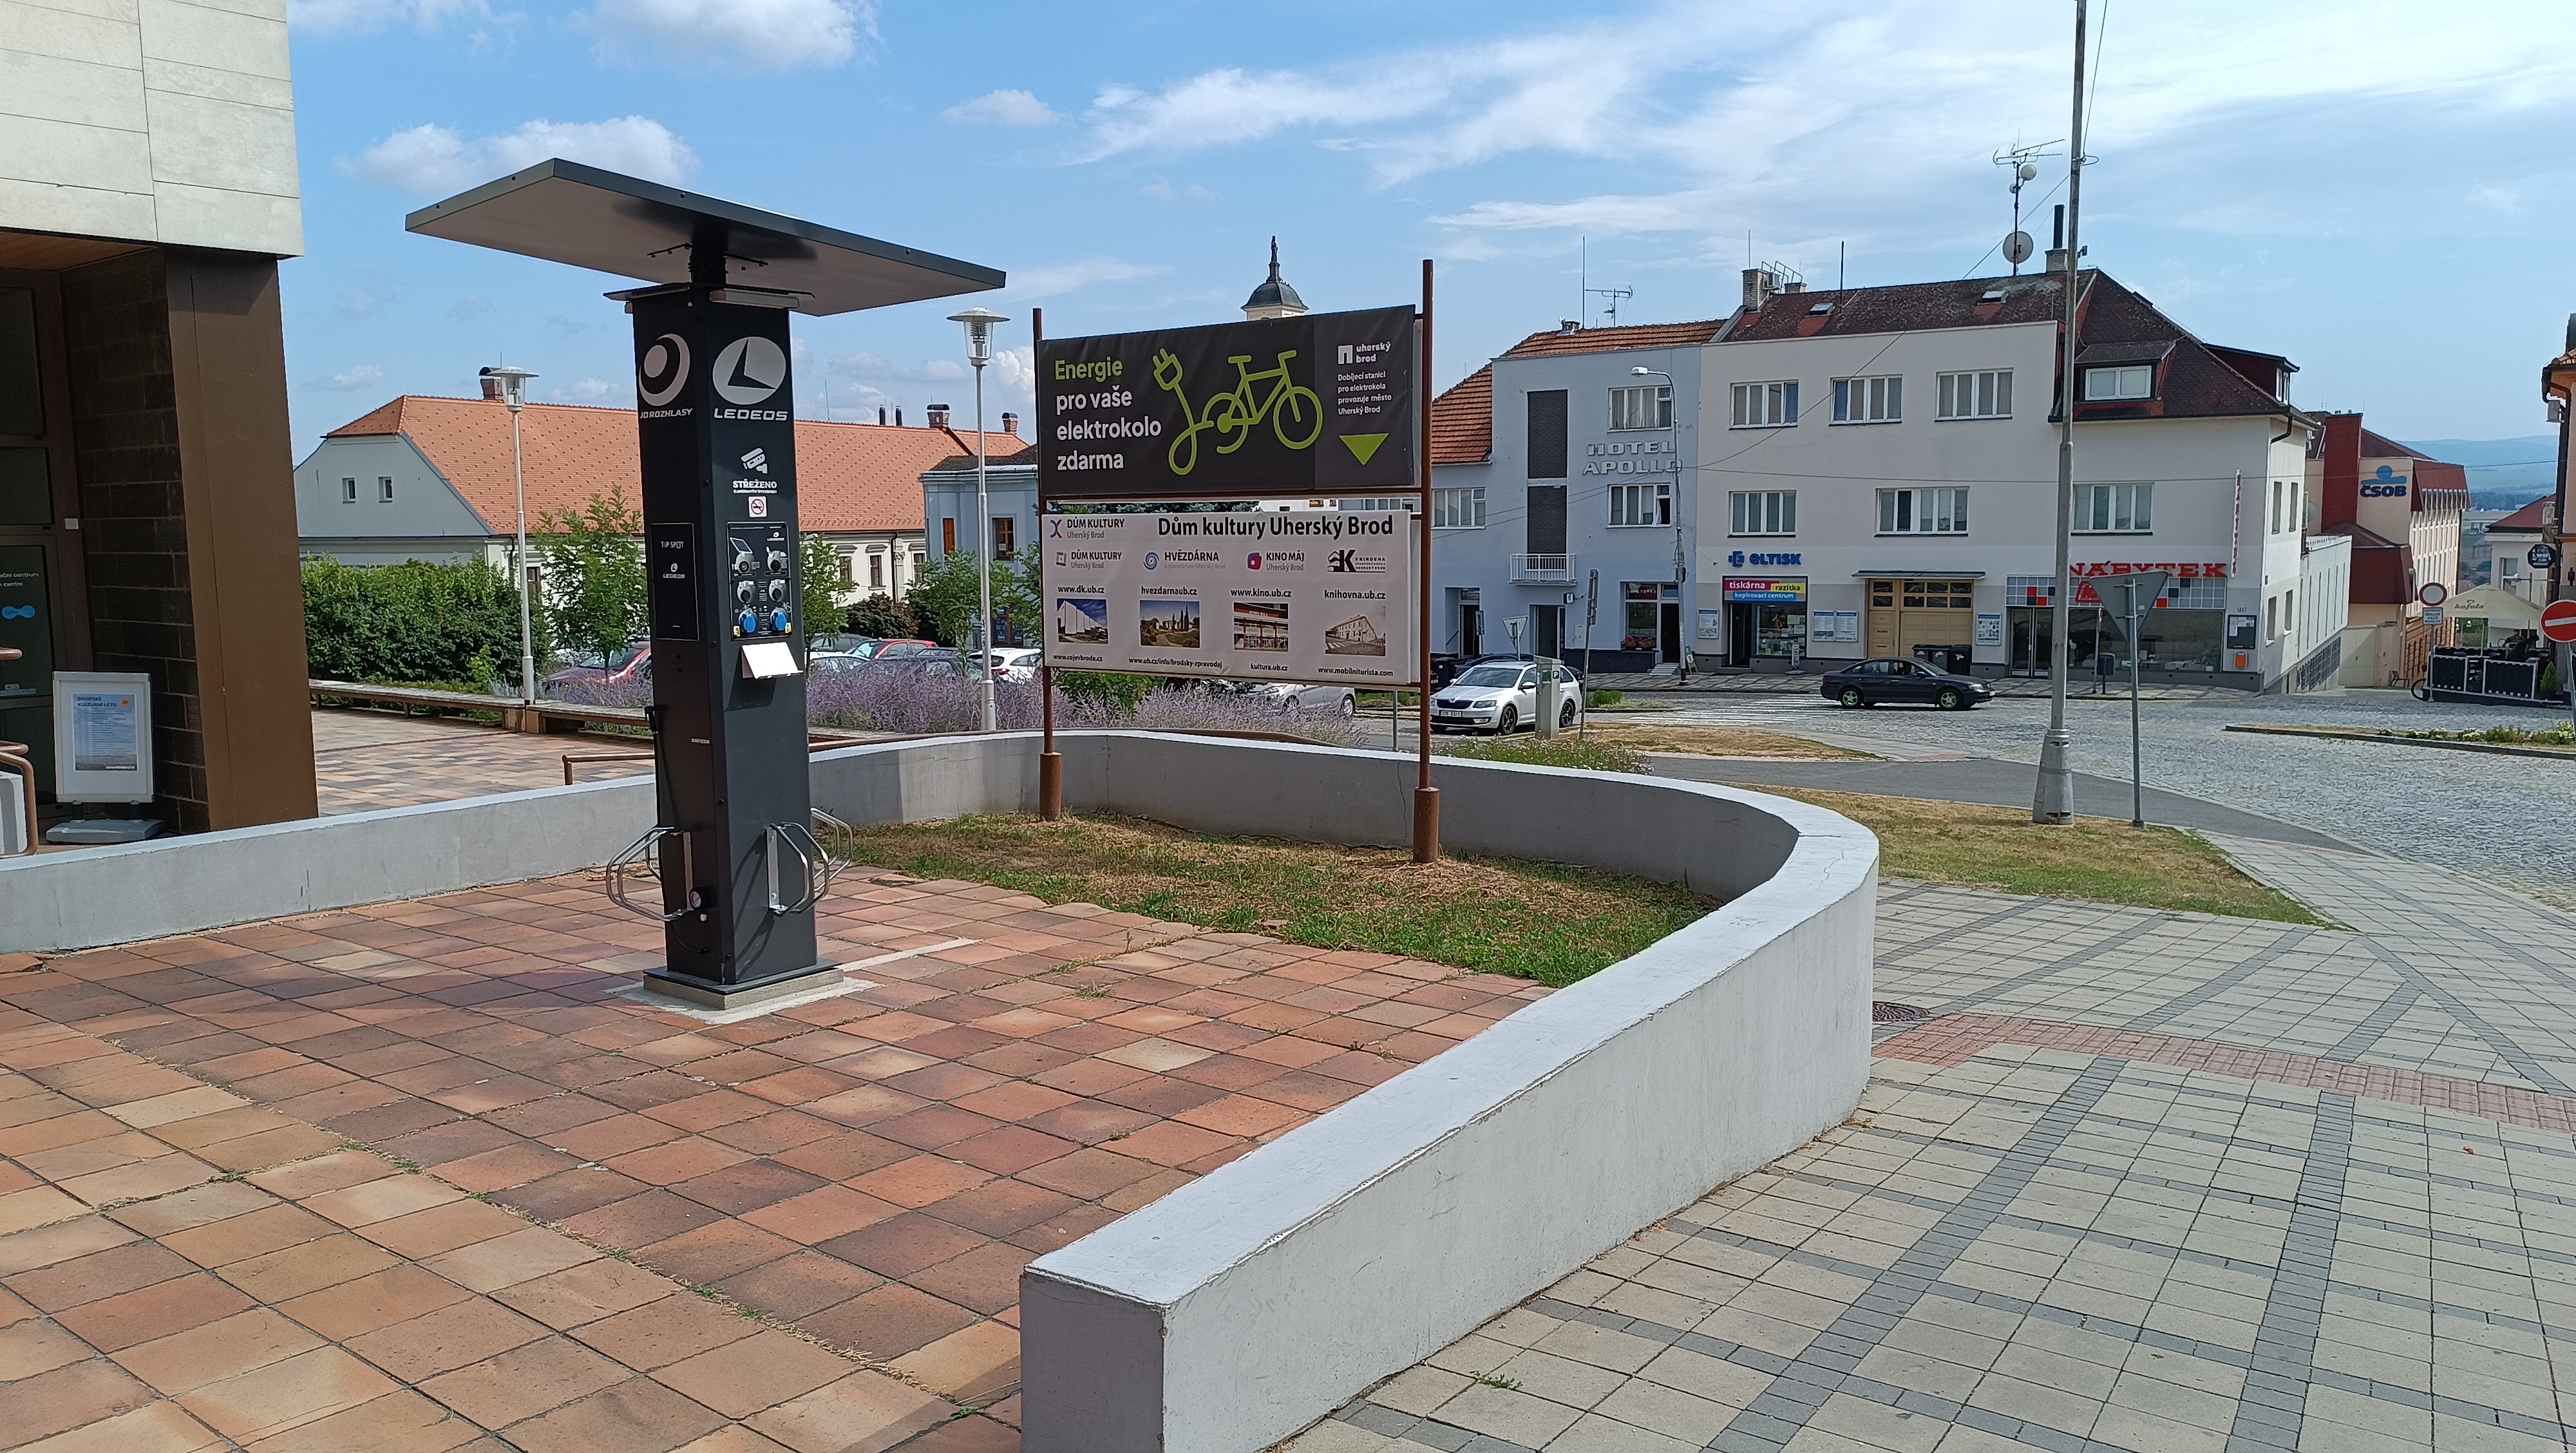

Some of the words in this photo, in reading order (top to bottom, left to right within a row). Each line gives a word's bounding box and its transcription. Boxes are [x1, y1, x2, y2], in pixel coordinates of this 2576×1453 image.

[1356, 341, 1391, 352] uherský
[1356, 354, 1376, 363] brod
[1055, 356, 1123, 383] Energie
[1350, 383, 1386, 392] elektrokola
[1056, 394, 1087, 415] pro
[1090, 385, 1133, 408] vaše
[1338, 395, 1369, 405] provozuje
[1370, 394, 1392, 402] město
[649, 408, 693, 418] ROZHLASY
[714, 408, 788, 421] LEDEOS
[1338, 406, 1364, 415] Uherský
[1364, 405, 1381, 413] Brod
[1057, 415, 1162, 441] elektrokolo
[1587, 441, 1676, 456] HOTEL
[1057, 450, 1124, 471] zdarma
[1582, 459, 1683, 475] APOLLO
[733, 479, 777, 489] STŘEŽENO
[2360, 484, 2407, 497] ČSOB
[1067, 516, 1086, 528] DŮM
[1088, 518, 1125, 528] KULTURY
[1159, 517, 1198, 536] Dům
[1202, 517, 1266, 540] kultury
[1270, 516, 1343, 540] Uherský
[1348, 515, 1393, 535] Brod
[1066, 531, 1090, 540] Uherský
[1071, 549, 1088, 560] DŮM
[1089, 551, 1122, 560] KULTURY
[1164, 549, 1219, 561] HVĚZDÁRNA
[1266, 552, 1287, 561] KINO
[1288, 549, 1305, 562] MÁJ
[1071, 562, 1092, 570] Uherský
[1266, 563, 1290, 572] Uherský
[2069, 560, 2227, 577] NÁBYTEK
[1141, 586, 1198, 595] hvezdarnaub.cz
[1231, 588, 1292, 598] www.kino.ub.cz
[1324, 589, 1386, 599] knihovna.ub.cz
[1251, 663, 1288, 671] kultura.ub.cz
[1318, 667, 1394, 676] www.mobilniturista.com
